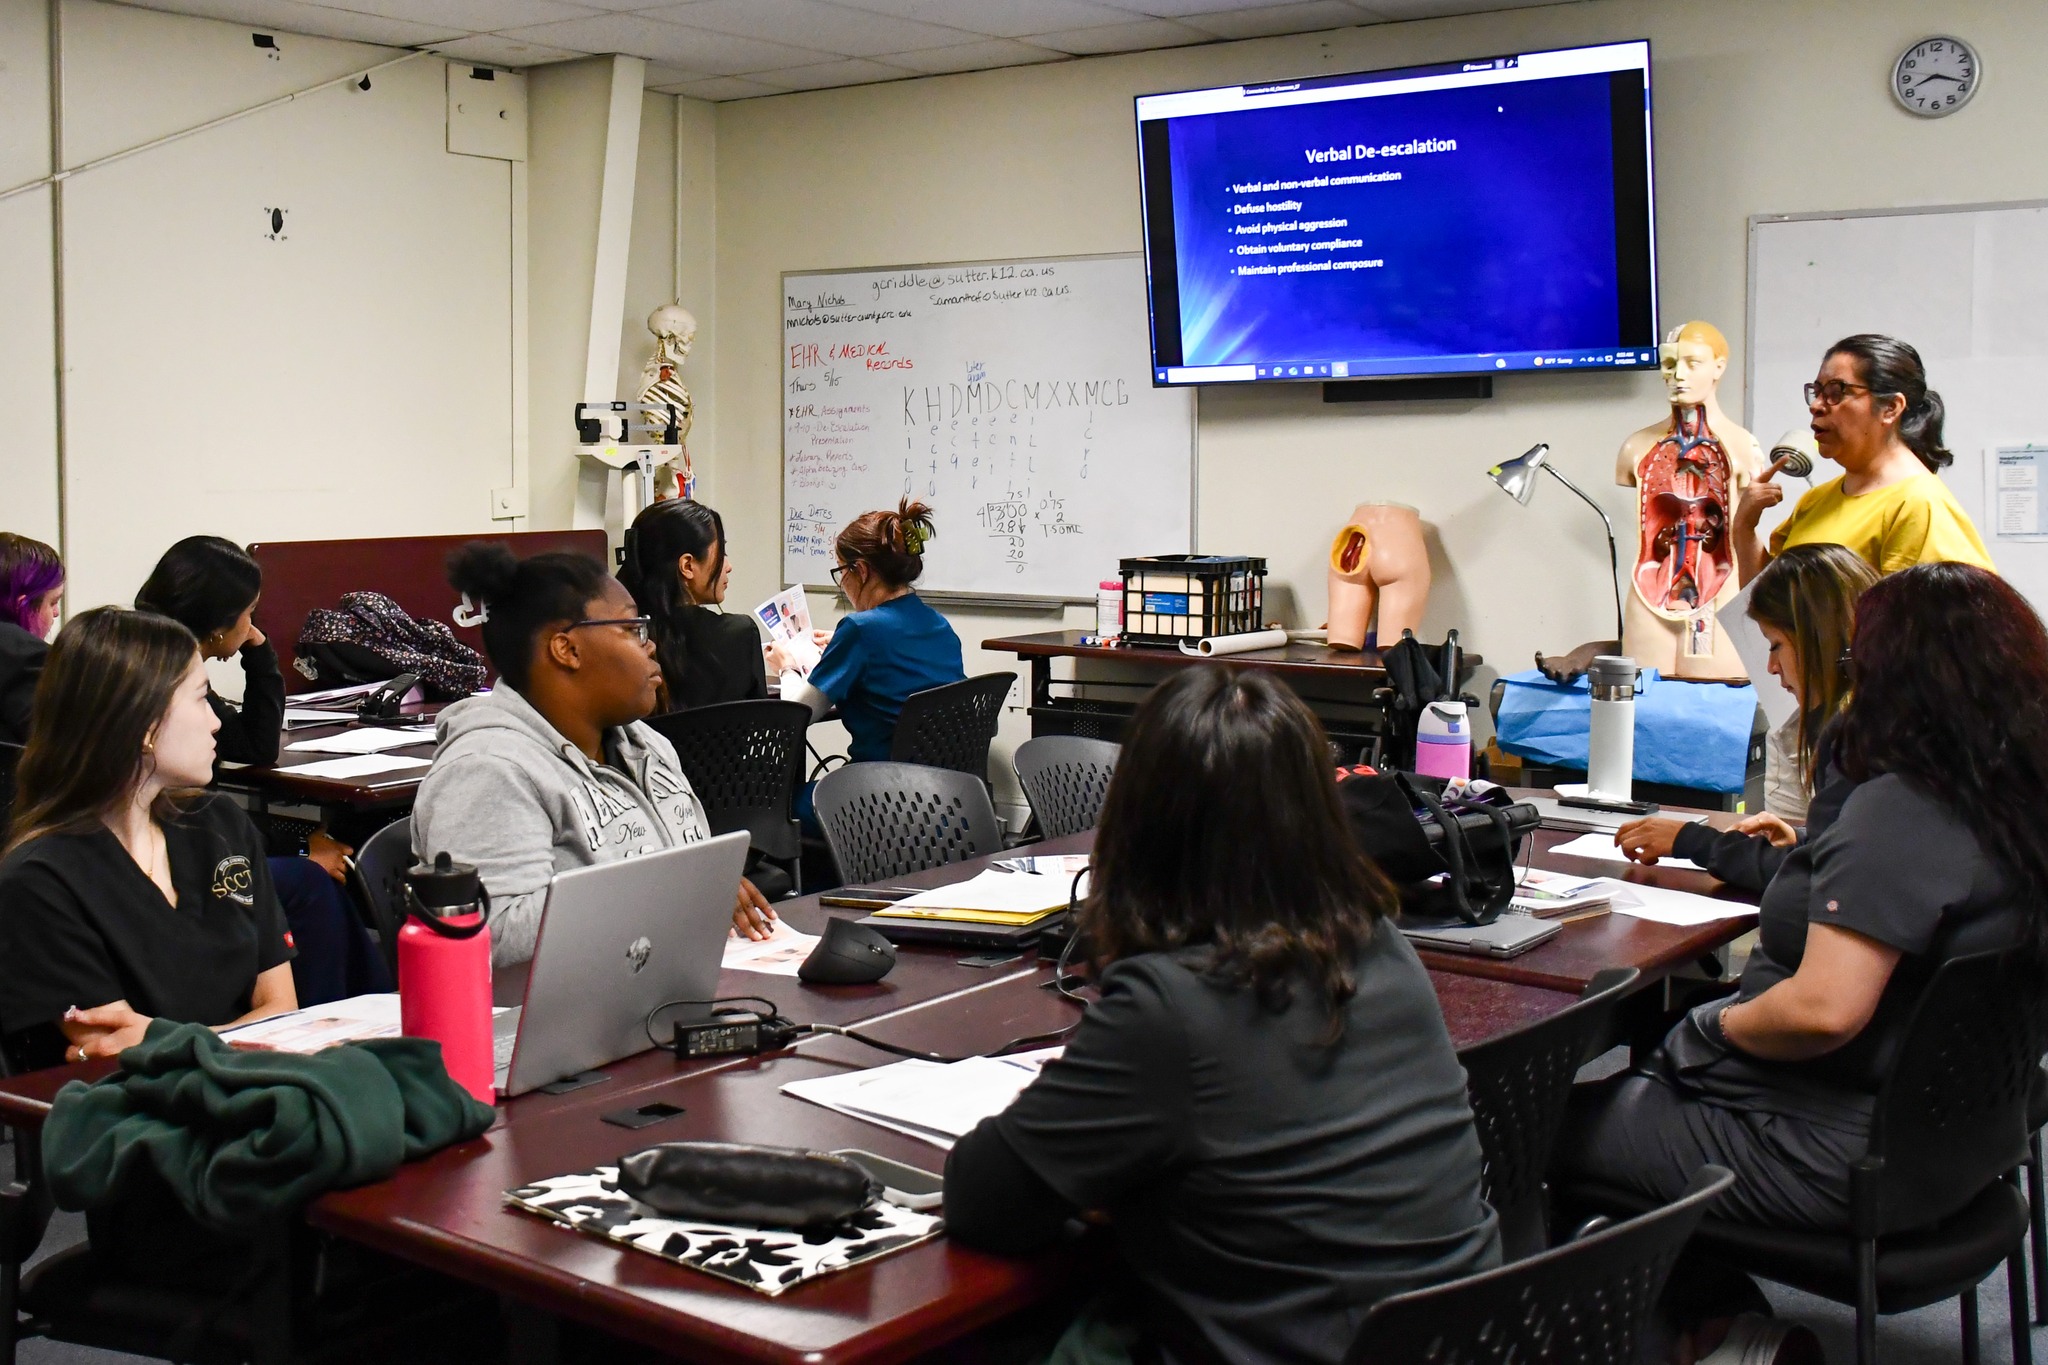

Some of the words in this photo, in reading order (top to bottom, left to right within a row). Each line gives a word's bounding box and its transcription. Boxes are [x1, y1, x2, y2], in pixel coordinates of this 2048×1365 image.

[1930, 42, 1943, 52] 12
[1951, 44, 1954, 54] 1
[1916, 48, 1925, 57] 11
[1906, 60, 1916, 68] 10
[1958, 54, 1968, 64] 2
[1961, 68, 1971, 78] 3
[1902, 74, 1912, 84] 9
[1958, 83, 1966, 92] 4
[1905, 88, 1915, 98] 8
[1916, 98, 1925, 108] 7
[1946, 95, 1956, 104] 5
[1931, 100, 1940, 110] 6
[1305, 145, 1351, 163] Verbal
[1355, 138, 1457, 159] De-escalation
[1233, 180, 1261, 194] Verbal
[1262, 179, 1279, 191] and
[1280, 176, 1329, 190] non-verbal
[1330, 170, 1402, 186] communication
[1234, 203, 1265, 215] Defuse
[1266, 200, 1302, 213] hostility
[1235, 223, 1260, 235] Avoid
[1262, 220, 1298, 235] physical
[1299, 217, 1348, 232] aggression
[1236, 244, 1267, 255] Obtain
[1268, 241, 1309, 254] voluntary
[1311, 237, 1363, 252] compliance
[1238, 264, 1276, 276] Maintain
[1277, 260, 1332, 275] professional
[1332, 257, 1384, 271] composure
[788, 296, 813, 313] Mary
[791, 343, 827, 369] EHR
[866, 356, 914, 371] Records
[1056, 511, 1065, 523] 2
[1009, 536, 1025, 548] 20
[1007, 549, 1024, 560] 20
[1016, 564, 1025, 574] 0
[615, 821, 647, 845] New
